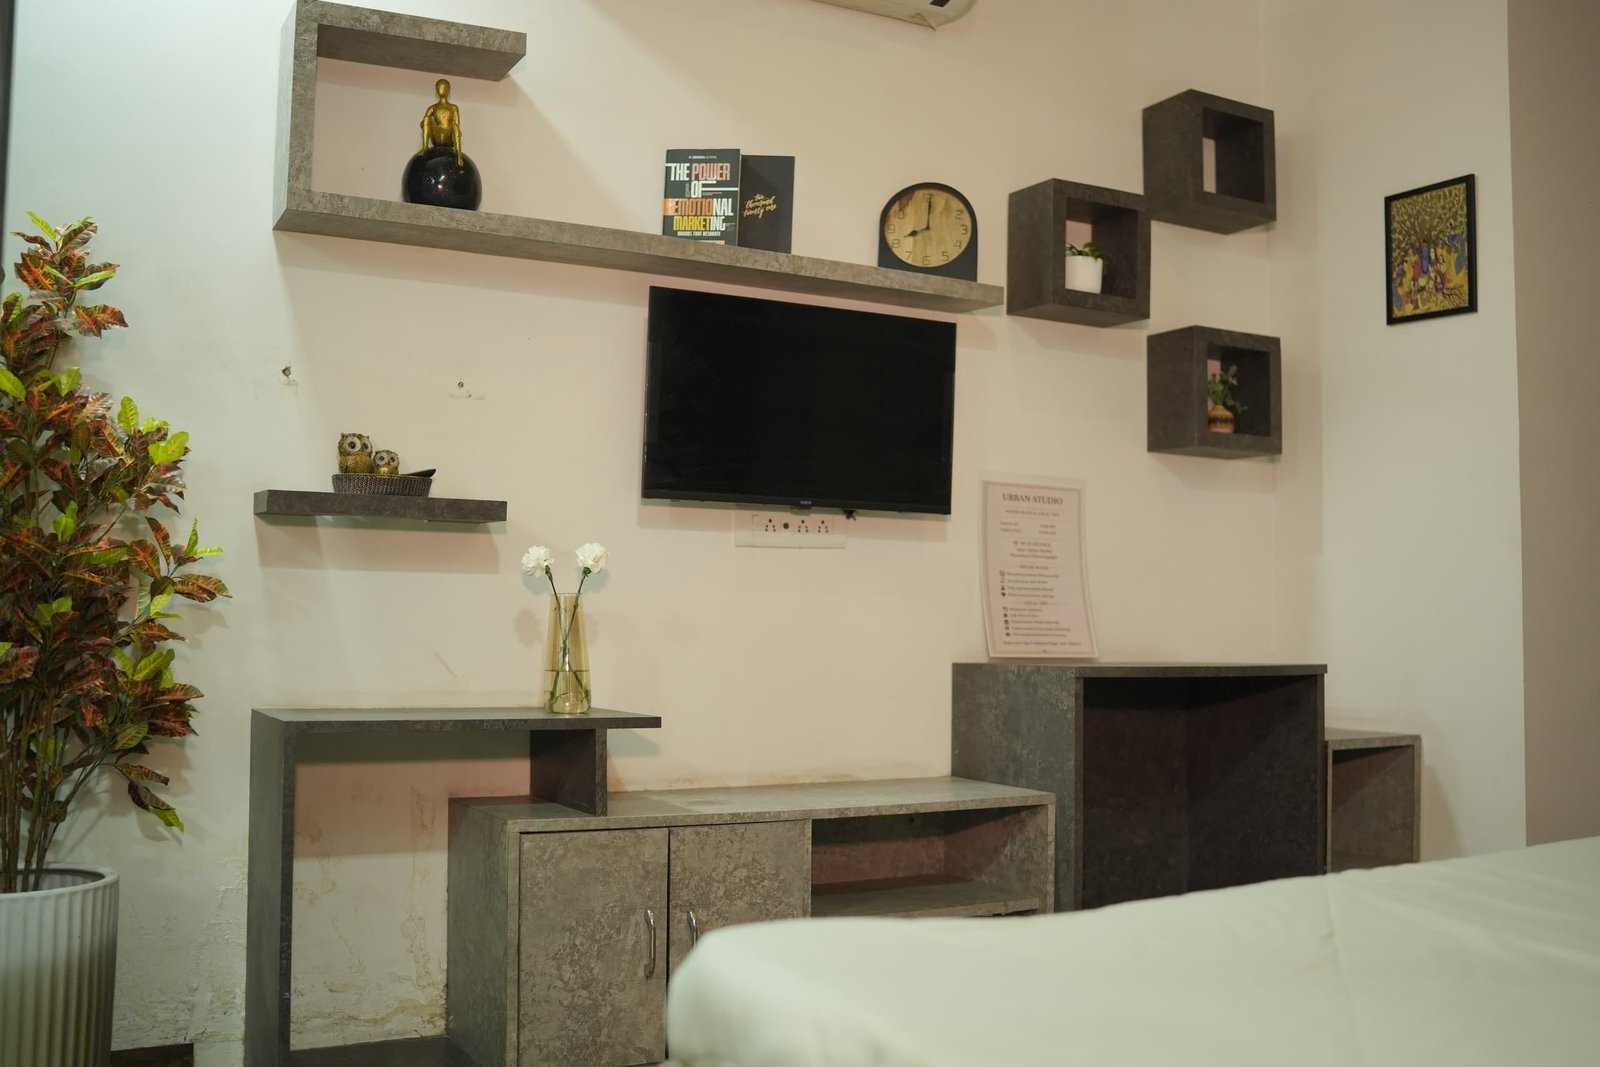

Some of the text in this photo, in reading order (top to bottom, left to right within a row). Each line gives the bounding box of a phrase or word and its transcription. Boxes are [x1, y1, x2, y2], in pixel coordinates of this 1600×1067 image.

[665, 163, 731, 181] THE POWER
[690, 180, 717, 198] OF
[668, 198, 734, 216] EMOTIONAL
[893, 209, 905, 220] 10
[954, 209, 964, 220] 2
[673, 215, 726, 231] MARKETING
[886, 223, 896, 234] 9
[960, 224, 969, 236] 3
[891, 238, 900, 249] 8
[953, 239, 963, 250] 4
[904, 250, 913, 261] 7
[921, 255, 931, 266] 6
[941, 251, 950, 262] 5
[1002, 493, 1064, 505] URBAN STUDIO
